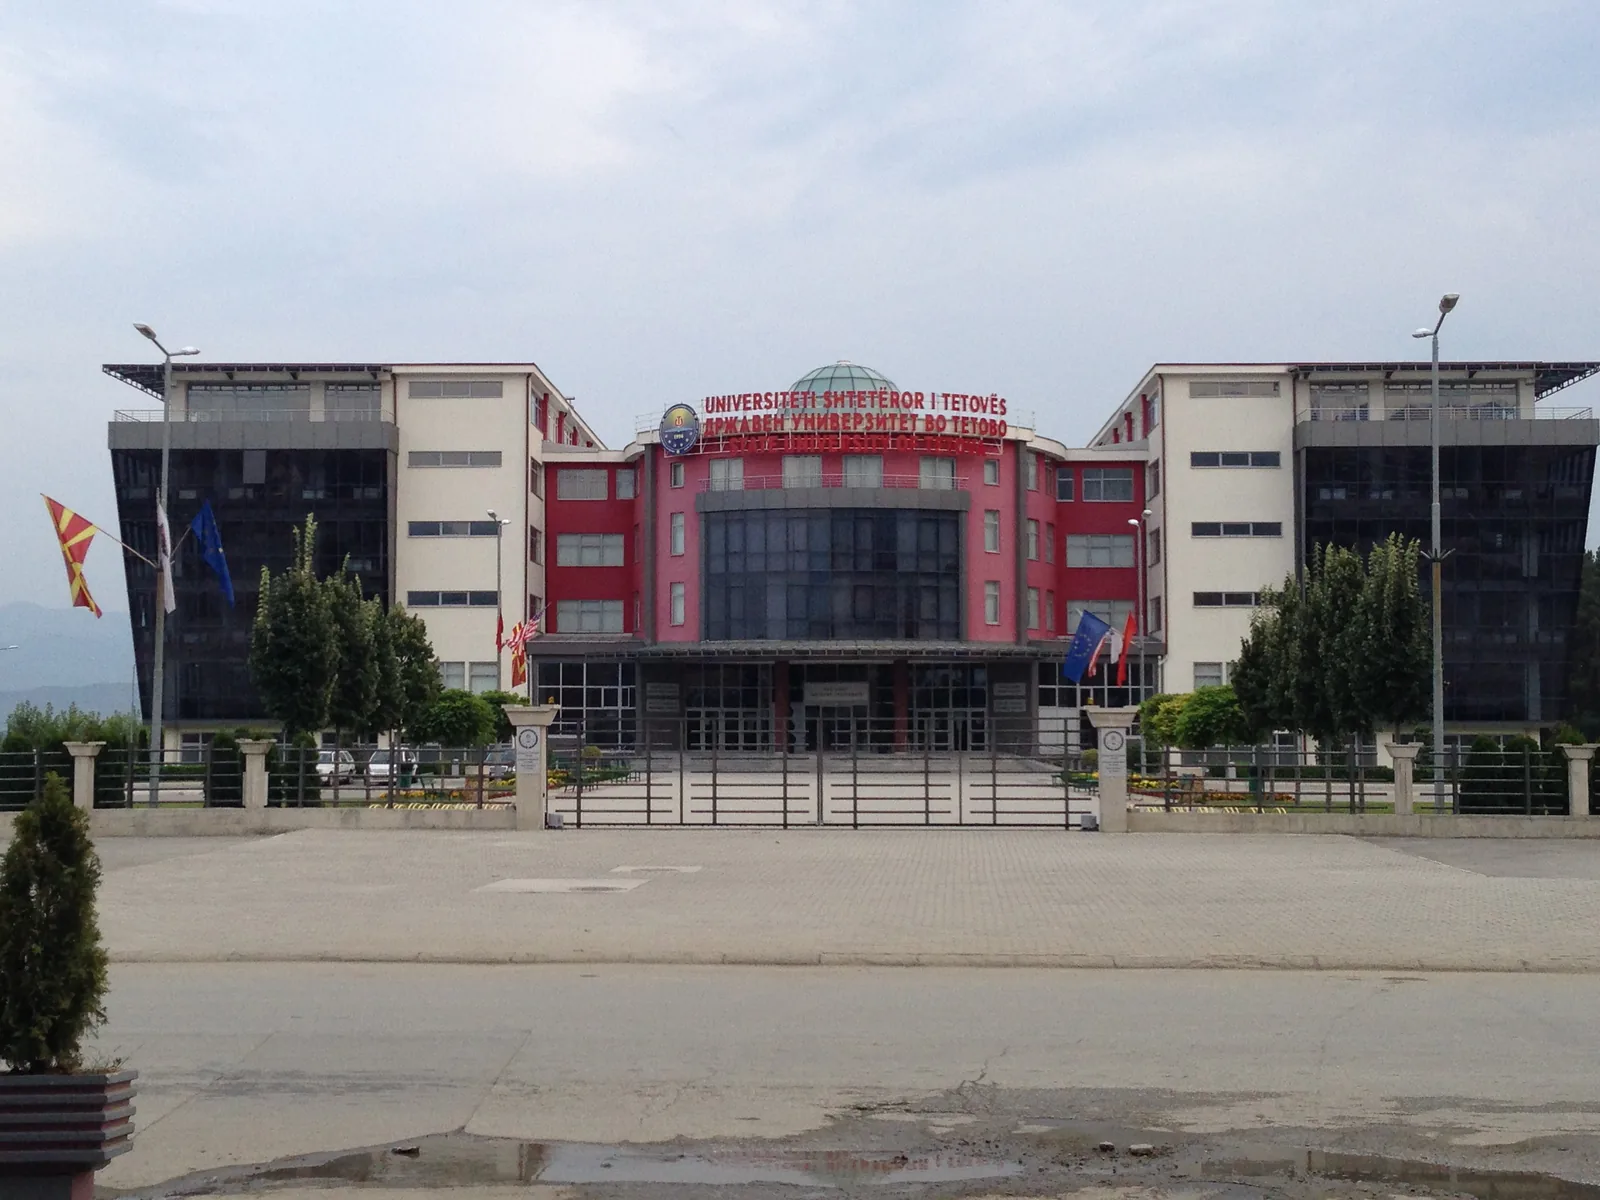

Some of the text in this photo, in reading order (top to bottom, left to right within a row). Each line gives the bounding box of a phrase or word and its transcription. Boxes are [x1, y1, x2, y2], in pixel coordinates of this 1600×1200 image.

[705, 386, 1007, 416] UNIVERSITETI SHTETËROR I TETOVËS
[703, 412, 1008, 438] ДРЖАВЕН УНИВЕРЗИТЕТ ВО ТЕТОВО
